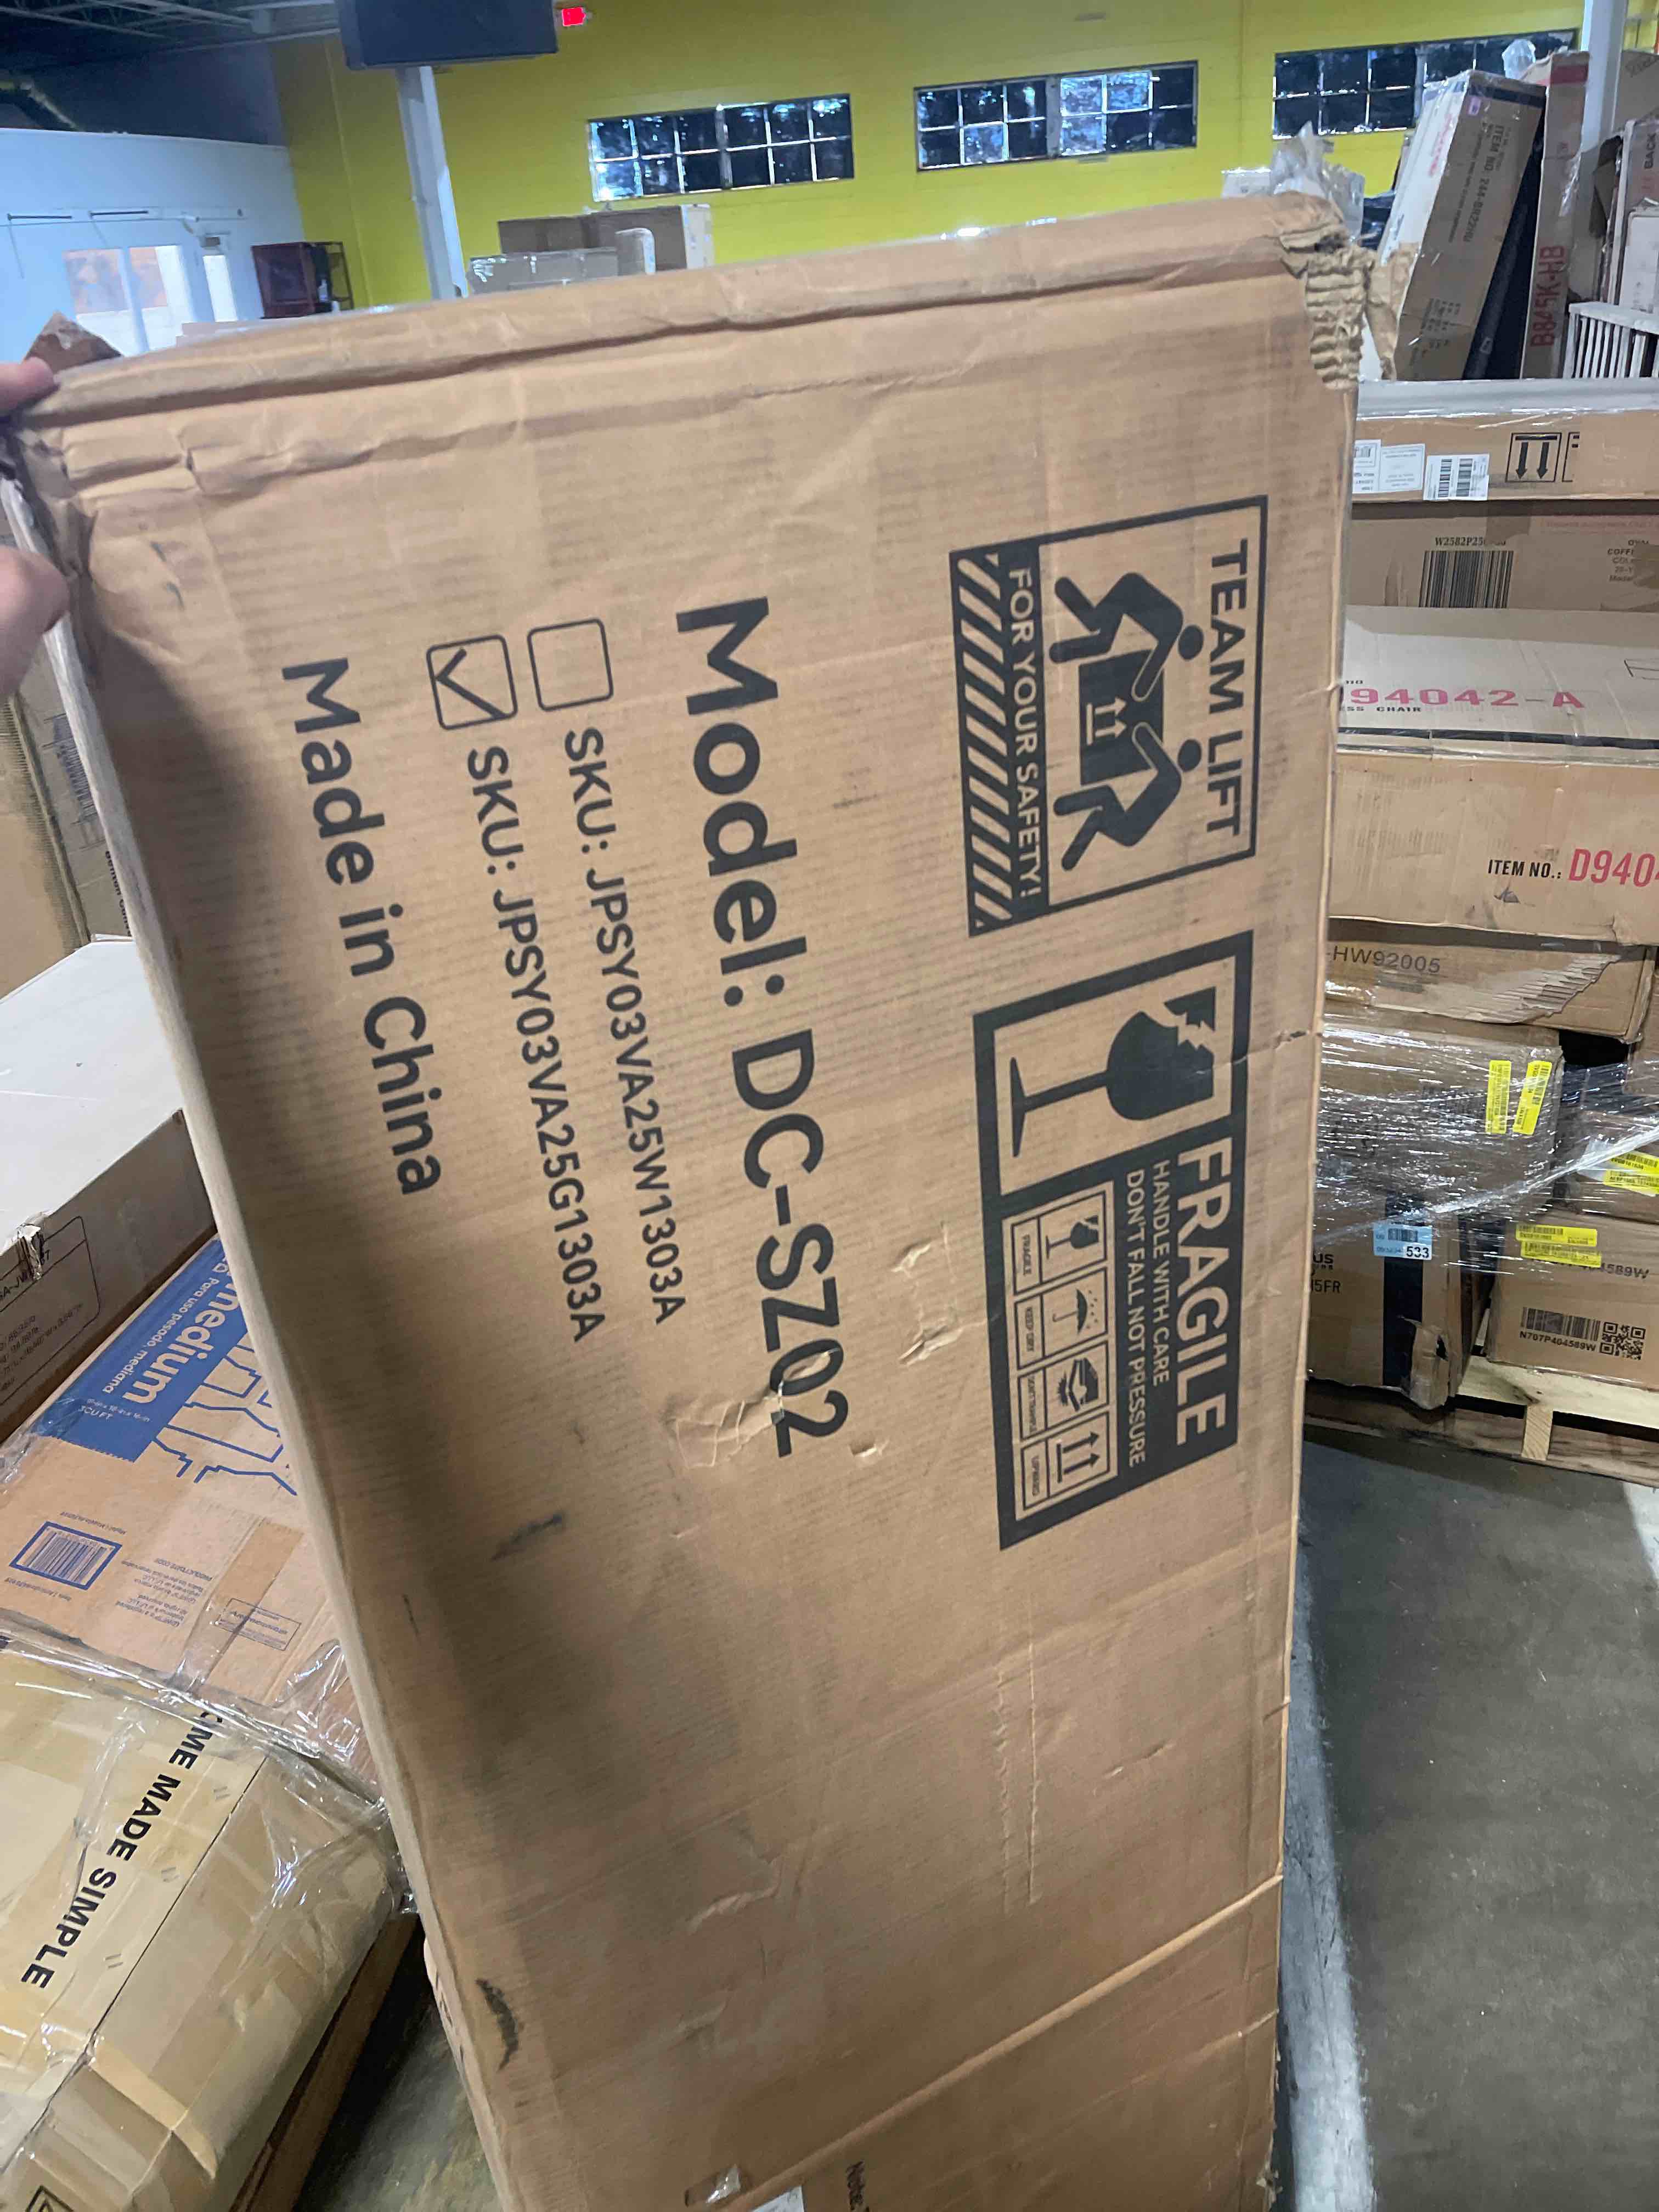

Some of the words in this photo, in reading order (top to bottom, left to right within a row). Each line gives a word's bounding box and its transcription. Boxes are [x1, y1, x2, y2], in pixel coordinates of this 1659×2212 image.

[1644, 133, 1656, 170] BACK
[1009, 568, 1034, 645] FOR
[1209, 539, 1249, 715] TEAM
[1013, 650, 1037, 757] YOUR
[1340, 687, 1585, 708] 94042-A
[281, 657, 385, 885] Made
[467, 746, 524, 875] SKU:
[565, 727, 617, 855] SKU:
[676, 596, 808, 1007] Model:
[1206, 731, 1243, 837] LIFT
[1015, 763, 1042, 899] SAFETY!
[1488, 859, 1525, 876] ITEM
[1529, 862, 1562, 879] NO.:
[338, 904, 403, 978] in
[364, 996, 442, 1195] China
[493, 889, 606, 1342] JPSY03VA25G1303A
[586, 868, 686, 1325] JPSY03VA25W1303A
[732, 1029, 849, 1458] DC-SZ02
[1126, 1169, 1146, 1242] DON'T
[1152, 1159, 1171, 1261] HANDLE
[1406, 1245, 1430, 1259] 533
[193, 1277, 219, 1297] Para
[1023, 1235, 1032, 1276] FRAGILE
[1127, 1247, 1146, 1302] FALL
[1153, 1263, 1171, 1324] WITH
[1177, 1137, 1233, 1446] FRAGILE
[179, 1297, 198, 1313] uso
[1128, 1305, 1146, 1353] NOT
[102, 1351, 148, 1393] mediana
[1152, 1327, 1170, 1387] CARE
[1128, 1358, 1146, 1468] PRESSURE
[106, 1774, 182, 1861] MADE
[21, 1866, 118, 1990] SIMPLE
